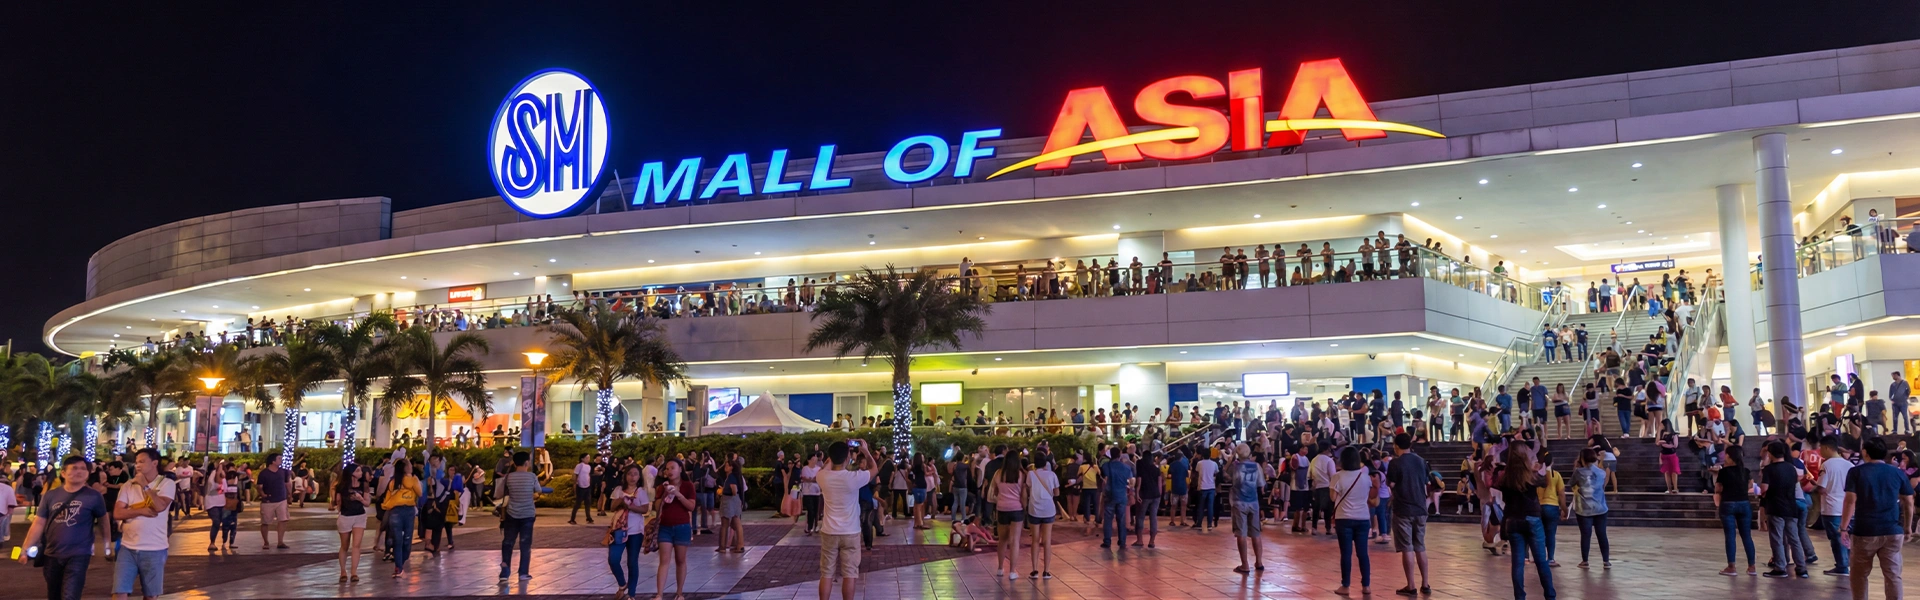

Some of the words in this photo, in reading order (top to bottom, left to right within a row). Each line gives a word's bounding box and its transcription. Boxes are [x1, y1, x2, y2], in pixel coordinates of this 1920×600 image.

[502, 88, 596, 199] SM
[631, 145, 853, 206] MALL
[883, 128, 1002, 183] OF
[1034, 57, 1388, 171] ASIA
